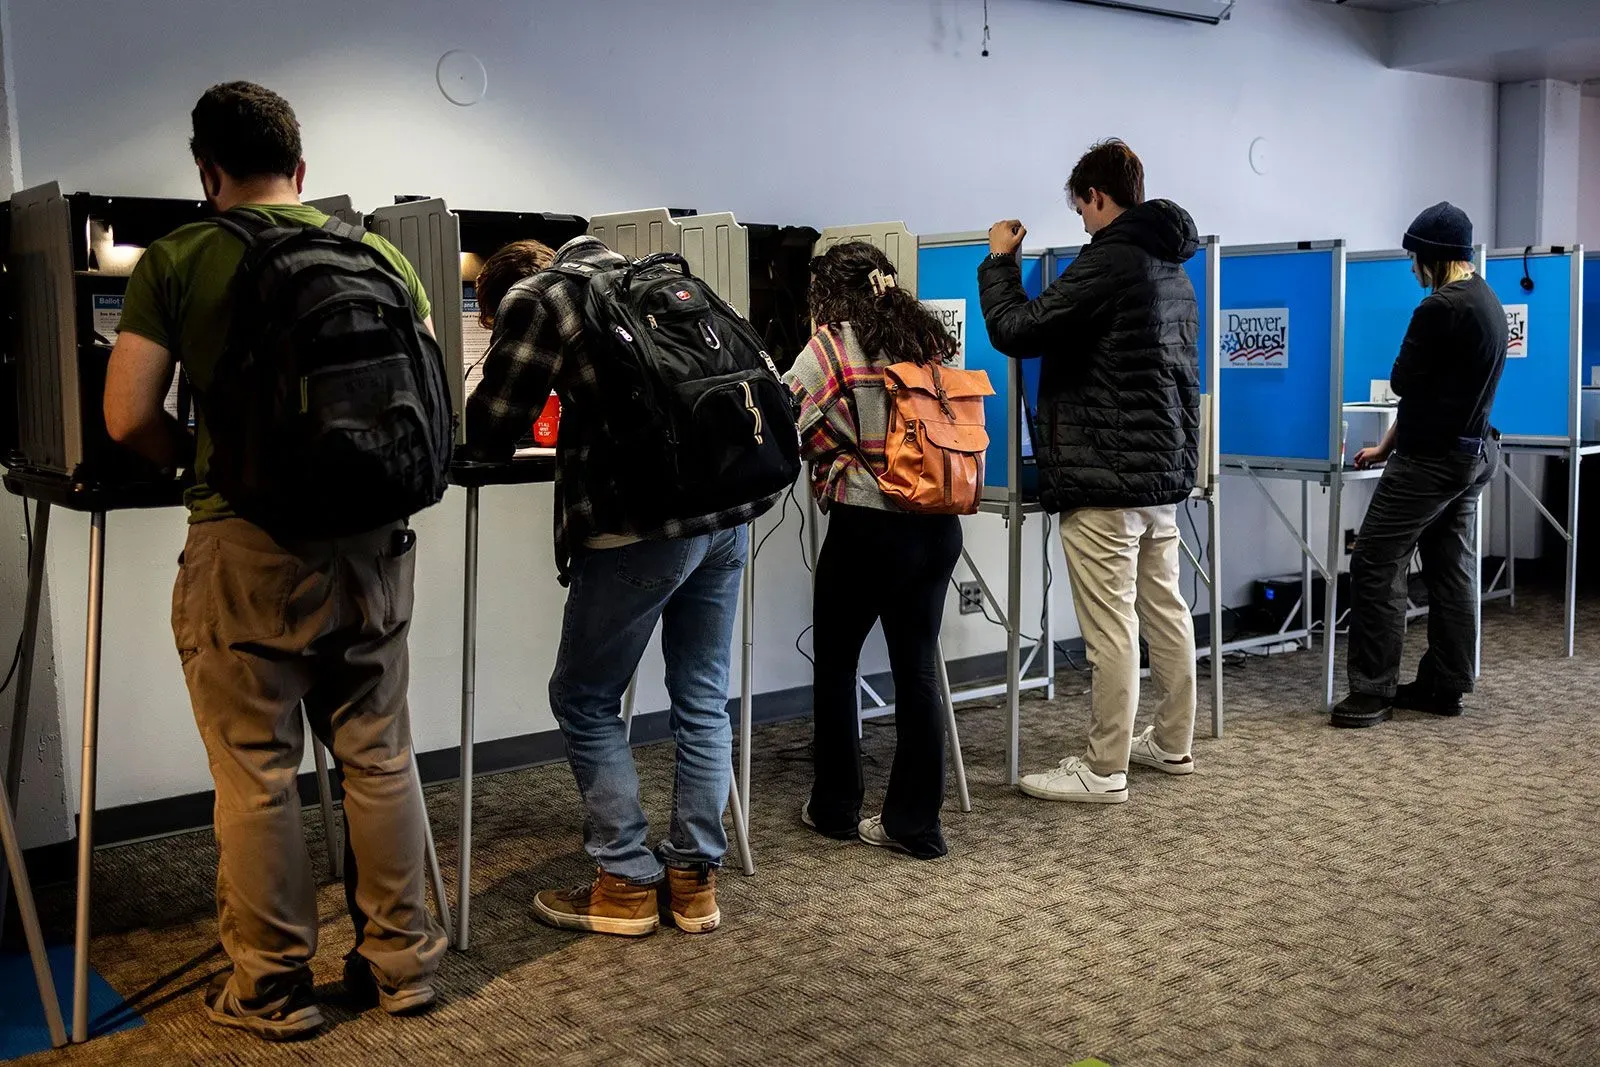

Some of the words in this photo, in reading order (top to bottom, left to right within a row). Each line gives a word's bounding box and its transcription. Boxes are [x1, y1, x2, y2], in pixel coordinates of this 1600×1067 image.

[99, 297, 120, 305] Ballot
[1228, 314, 1281, 332] Denver
[1235, 326, 1285, 350] Votes!
